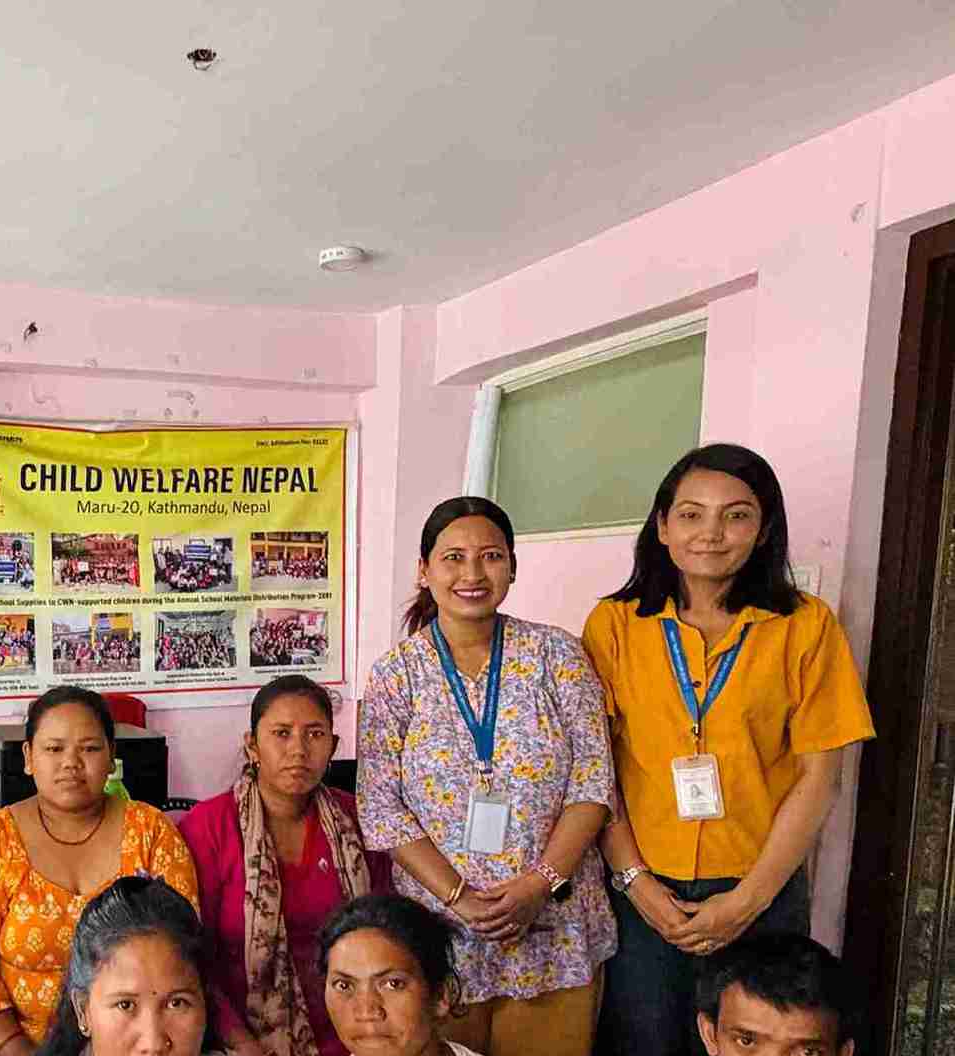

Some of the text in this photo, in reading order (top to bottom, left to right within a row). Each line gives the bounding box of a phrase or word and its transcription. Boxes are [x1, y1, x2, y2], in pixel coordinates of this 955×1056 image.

[20, 463, 319, 493] CHILD WELFARE NEPAL
[77, 500, 271, 517] Maru-20, Kathmandu, Nepal
